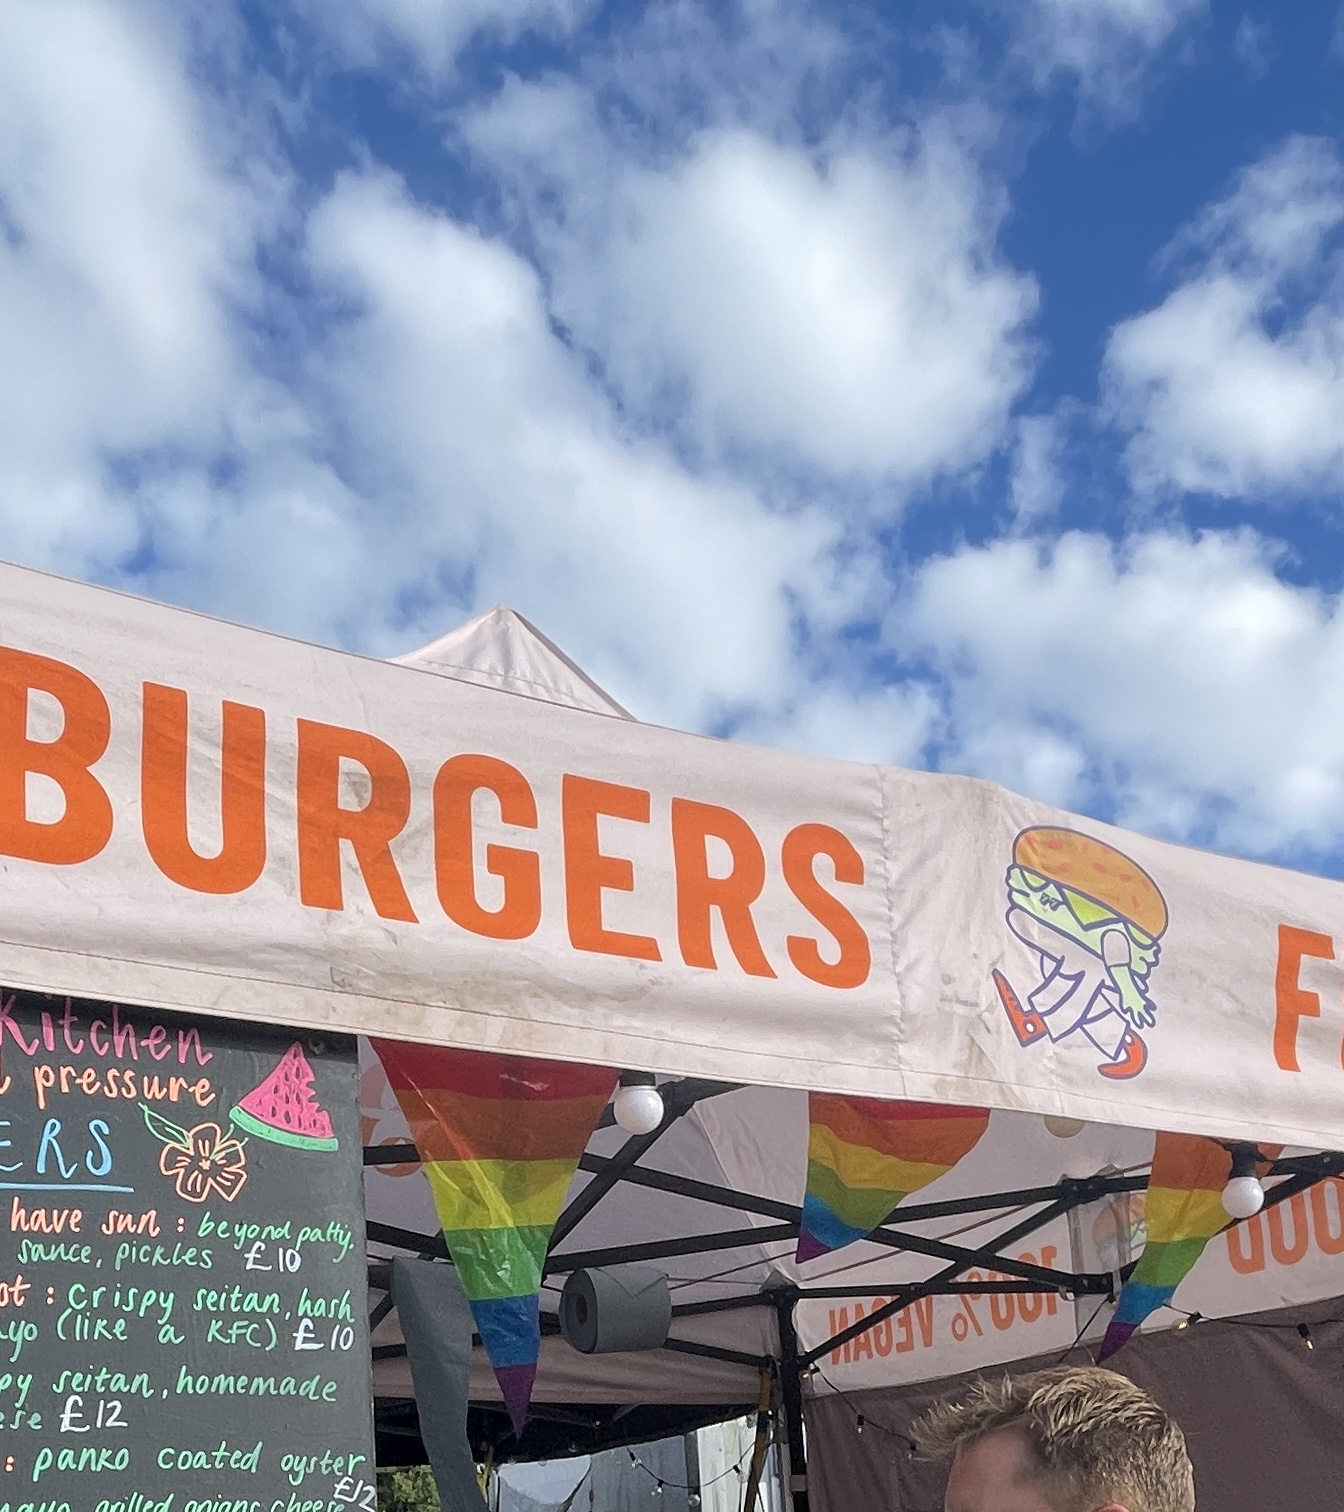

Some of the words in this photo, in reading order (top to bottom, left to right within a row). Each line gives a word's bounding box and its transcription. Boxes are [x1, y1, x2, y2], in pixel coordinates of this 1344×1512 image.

[35, 1054, 215, 1109] pressure
[11, 1197, 82, 1233] have
[198, 1212, 291, 1250] beyond
[115, 1243, 212, 1270] pickles
[244, 1241, 301, 1272] £10
[69, 1284, 174, 1324] crispy
[298, 1288, 355, 1322] hash
[293, 1318, 353, 1350] £10
[176, 1365, 336, 1401] homemade
[158, 1441, 262, 1473] coated
[281, 1450, 365, 1482] oyster
